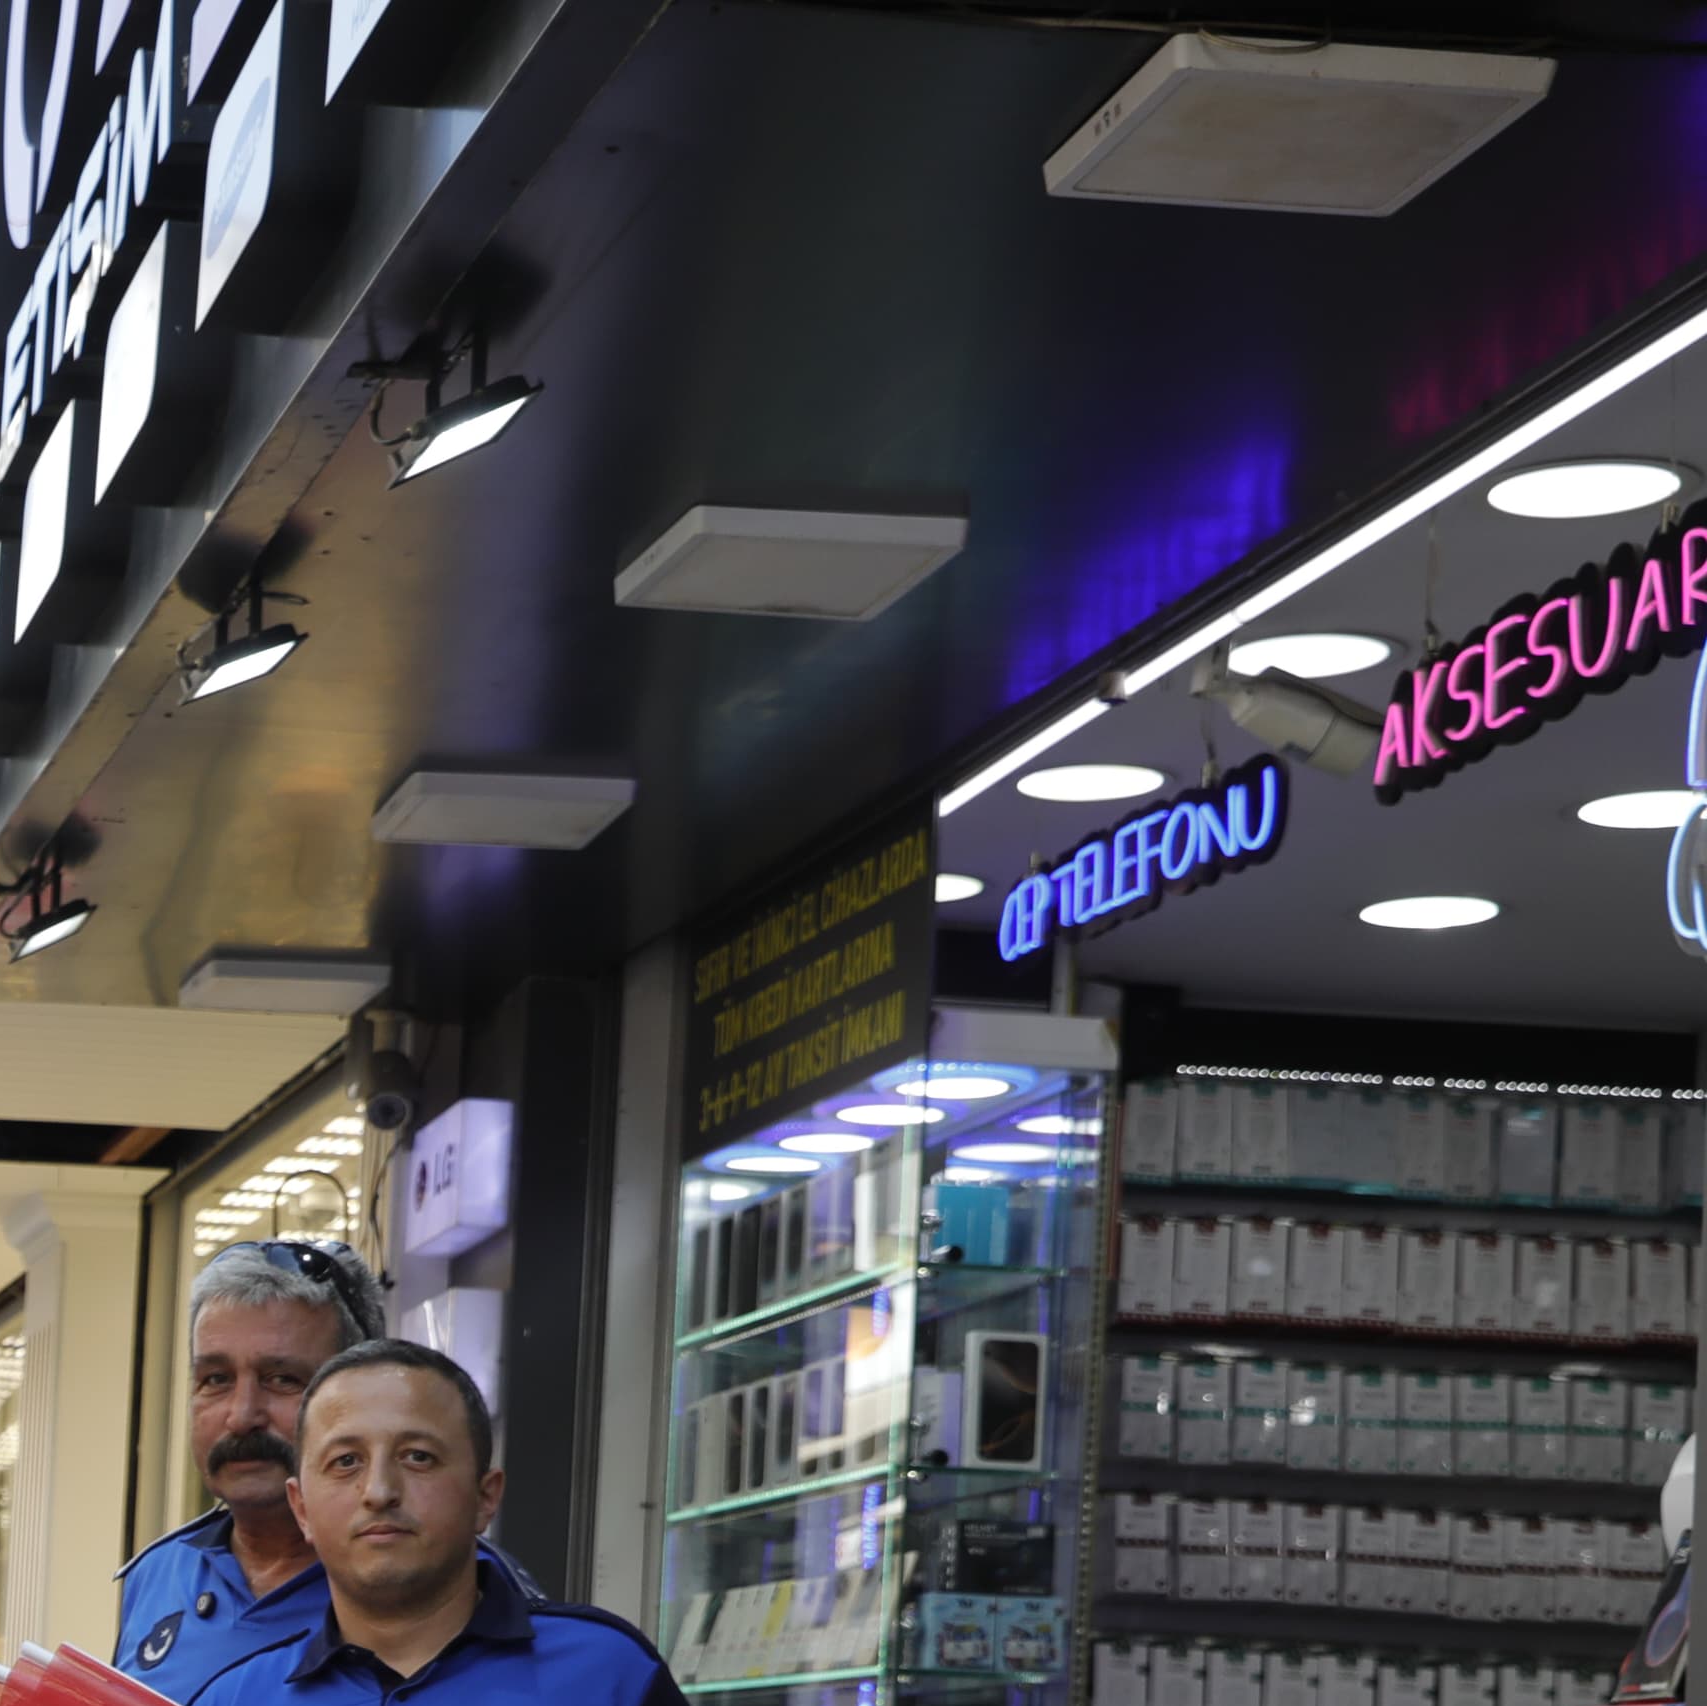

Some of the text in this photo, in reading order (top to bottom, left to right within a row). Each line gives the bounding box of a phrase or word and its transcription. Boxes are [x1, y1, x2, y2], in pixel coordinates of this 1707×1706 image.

[1373, 527, 1707, 786] AKSESUAR
[999, 766, 1278, 962] CEP TELEFONU
[433, 1143, 456, 1197] LG
